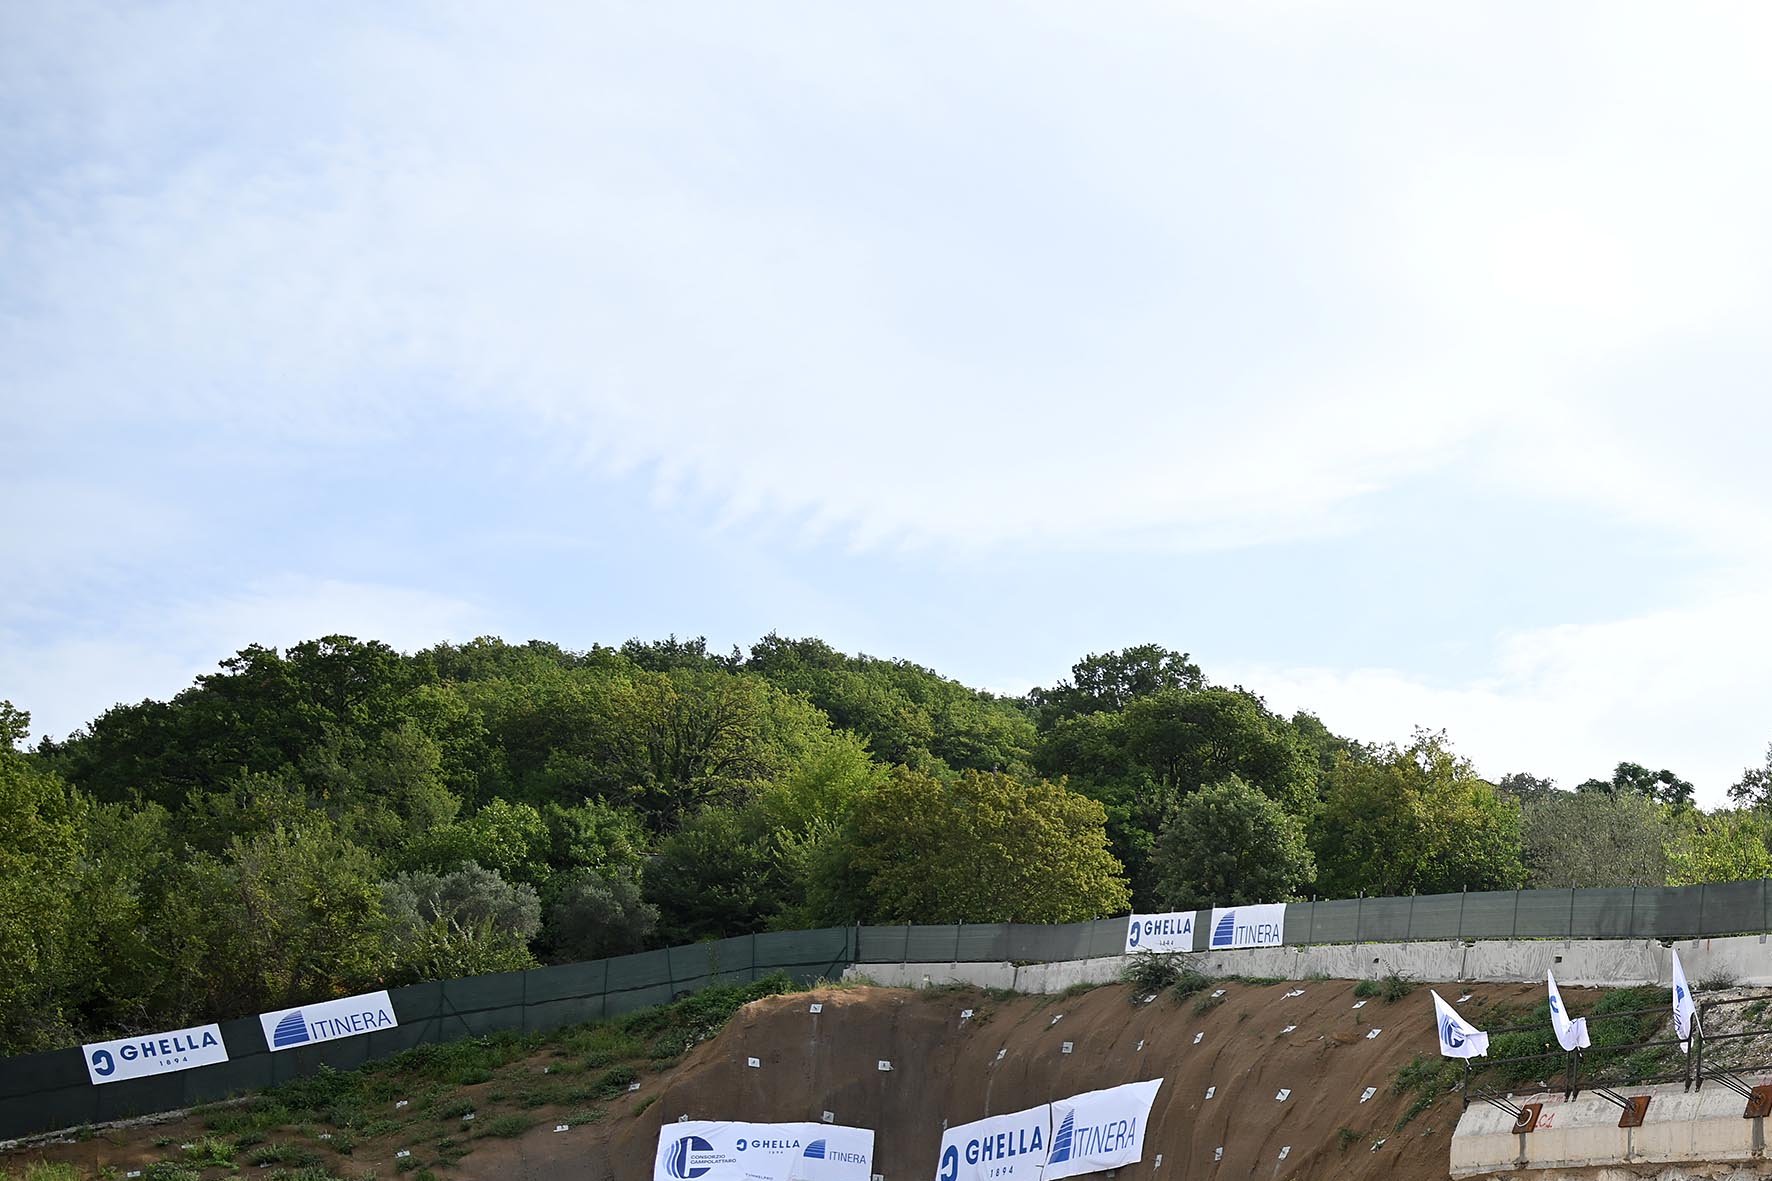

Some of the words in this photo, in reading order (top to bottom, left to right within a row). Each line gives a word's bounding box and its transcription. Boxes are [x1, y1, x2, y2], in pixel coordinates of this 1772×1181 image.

[1144, 918, 1191, 936] GHELLA
[1234, 923, 1280, 945] ITINERA
[311, 1009, 392, 1040] ITINERA
[119, 1031, 218, 1061] GHELLA
[159, 1056, 188, 1067] 1894
[751, 1139, 800, 1149] GHELLA
[965, 1126, 1043, 1165] GHELLA
[1072, 1117, 1137, 1159] ITINERA
[829, 1151, 867, 1165] ITINERA
[990, 1165, 1014, 1178] 1894
